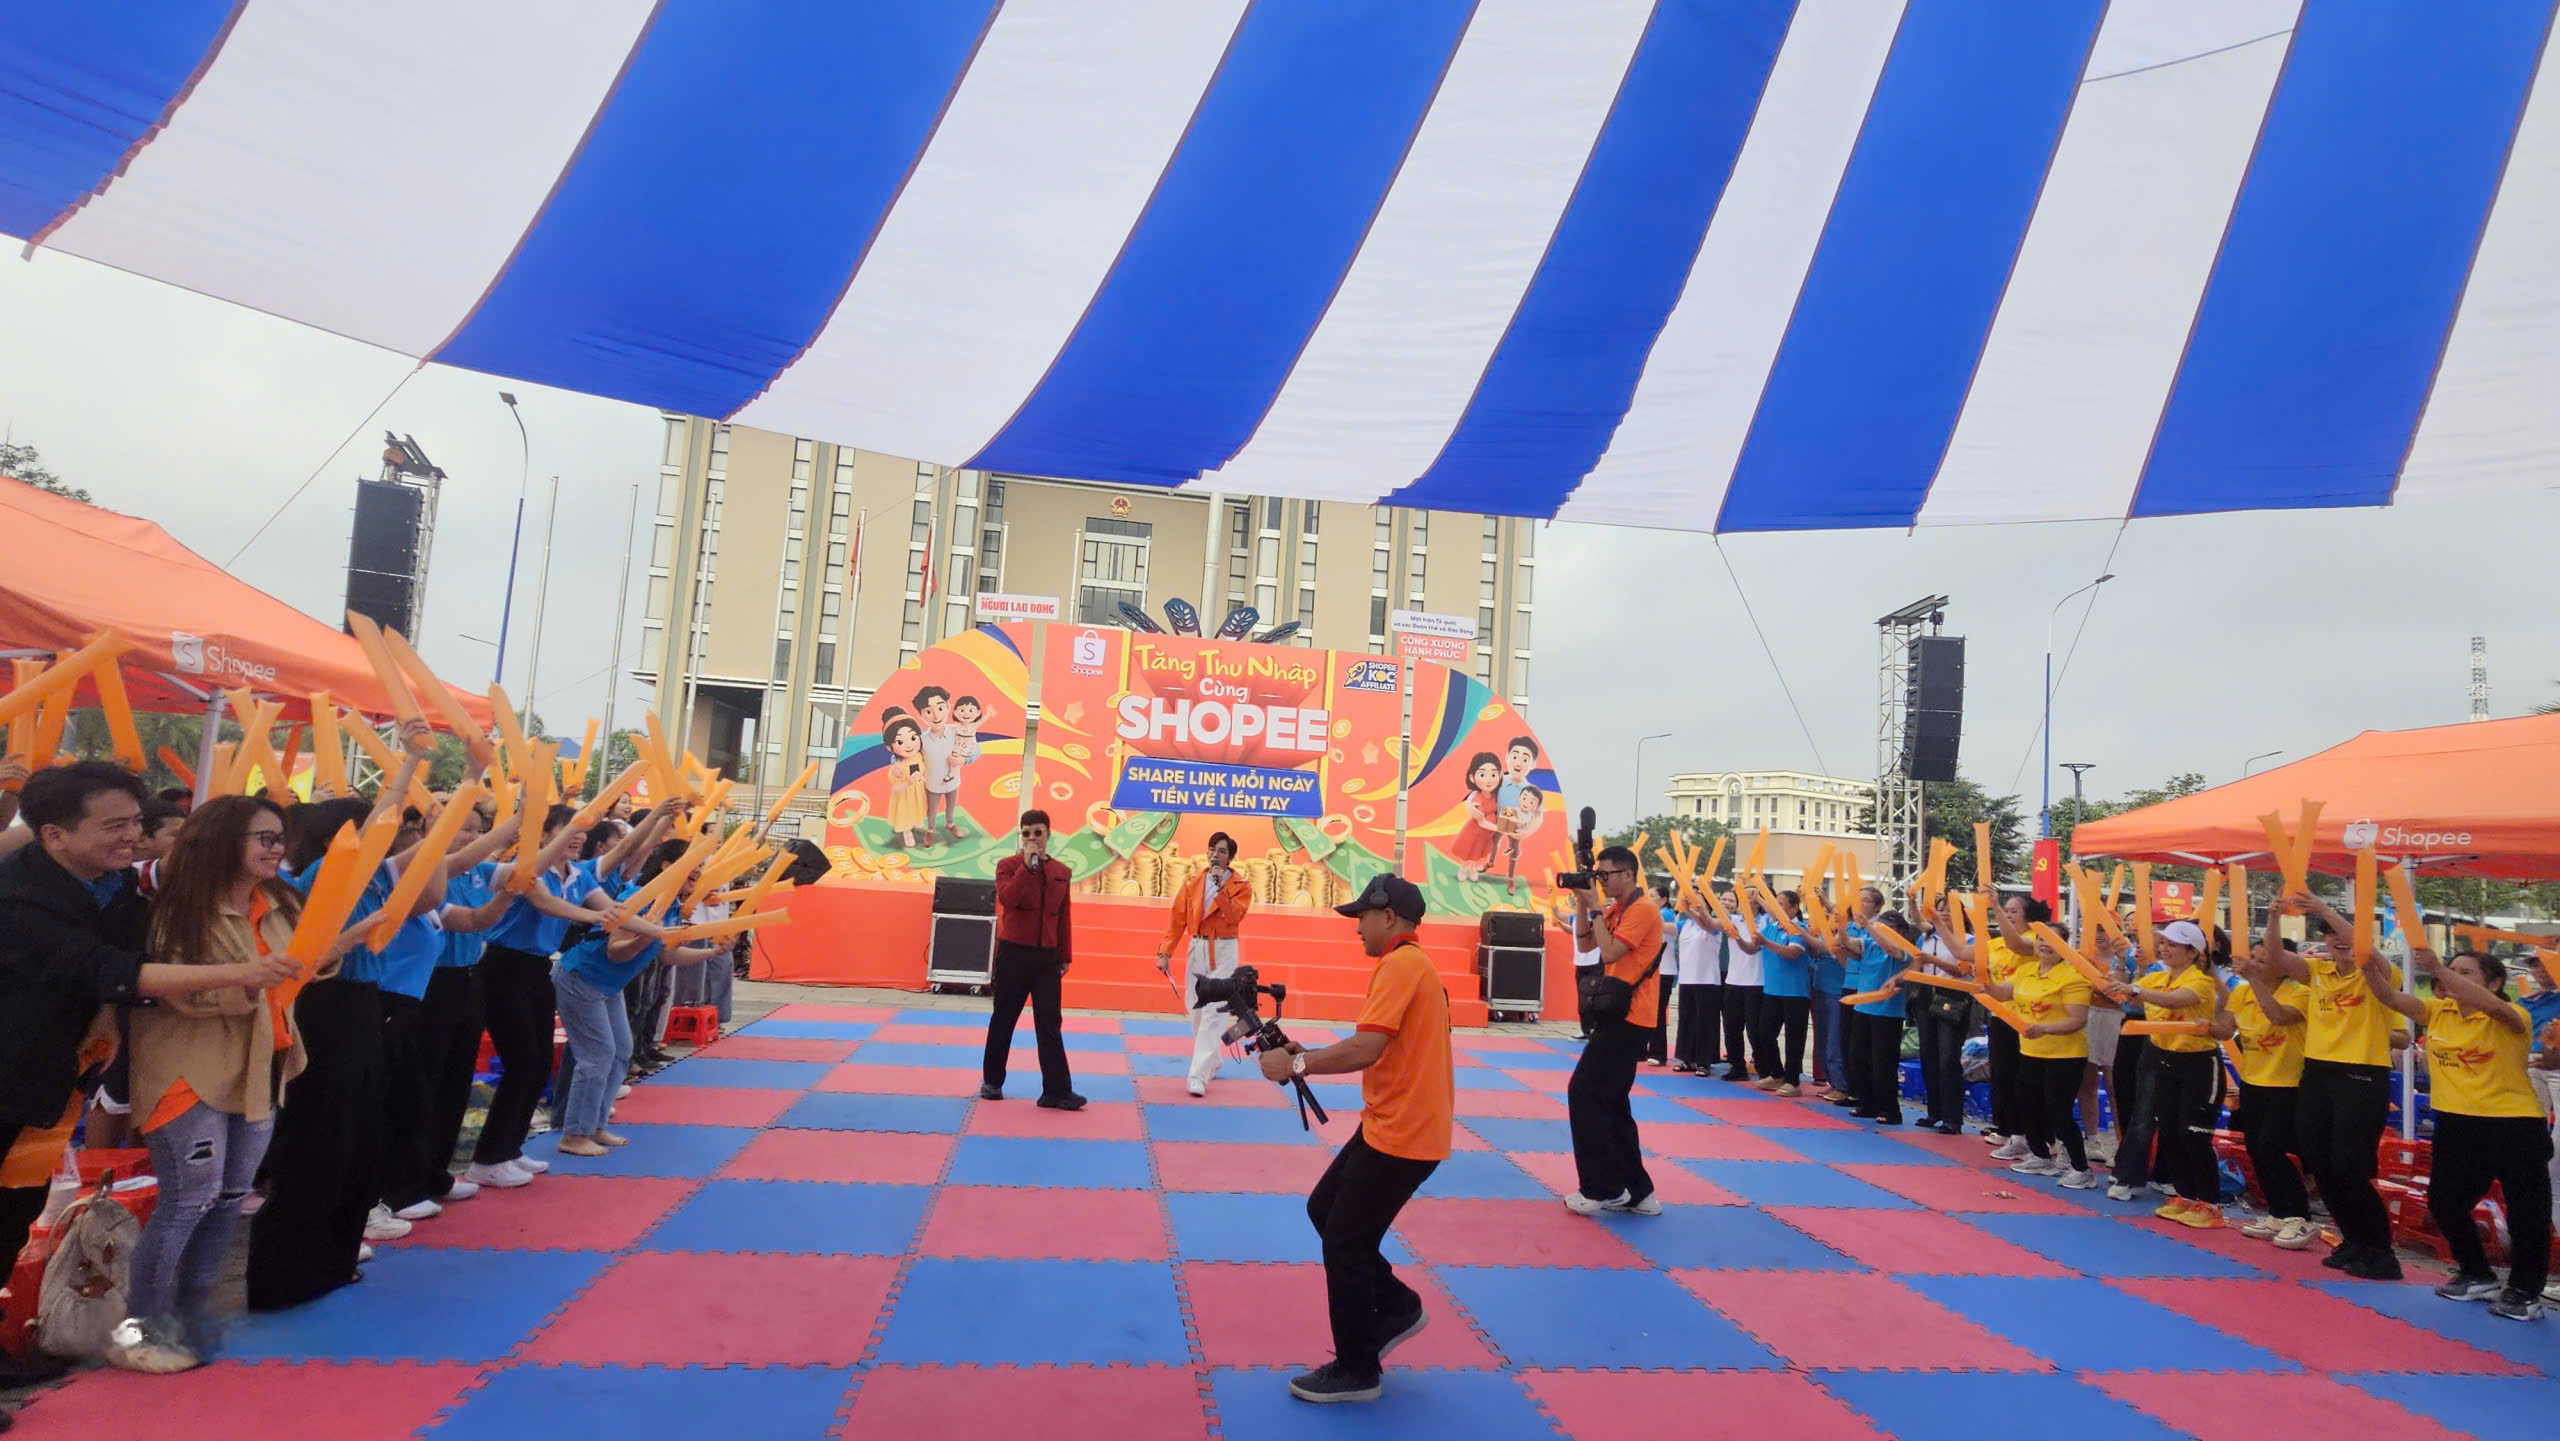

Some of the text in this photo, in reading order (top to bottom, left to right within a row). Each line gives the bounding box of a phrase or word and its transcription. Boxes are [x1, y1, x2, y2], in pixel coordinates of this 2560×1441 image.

[1010, 602, 1028, 613] LAO
[207, 645, 276, 683] Shopee
[1071, 664, 1104, 677] Shopee
[1134, 644, 1318, 690] Tăng Thu Nhập
[1368, 662, 1397, 671] SHOPEE
[1368, 669, 1396, 683] KOC
[1199, 677, 1248, 704] Cùng
[1360, 680, 1396, 691] AFFILIATE
[1116, 695, 1329, 752] SHOPEE
[1128, 766, 1315, 793] SHARE LINK MỖI NGÀY
[1150, 784, 1291, 812] TIỀN VỀ LIỀN TAY
[2381, 826, 2473, 851] Shopee
